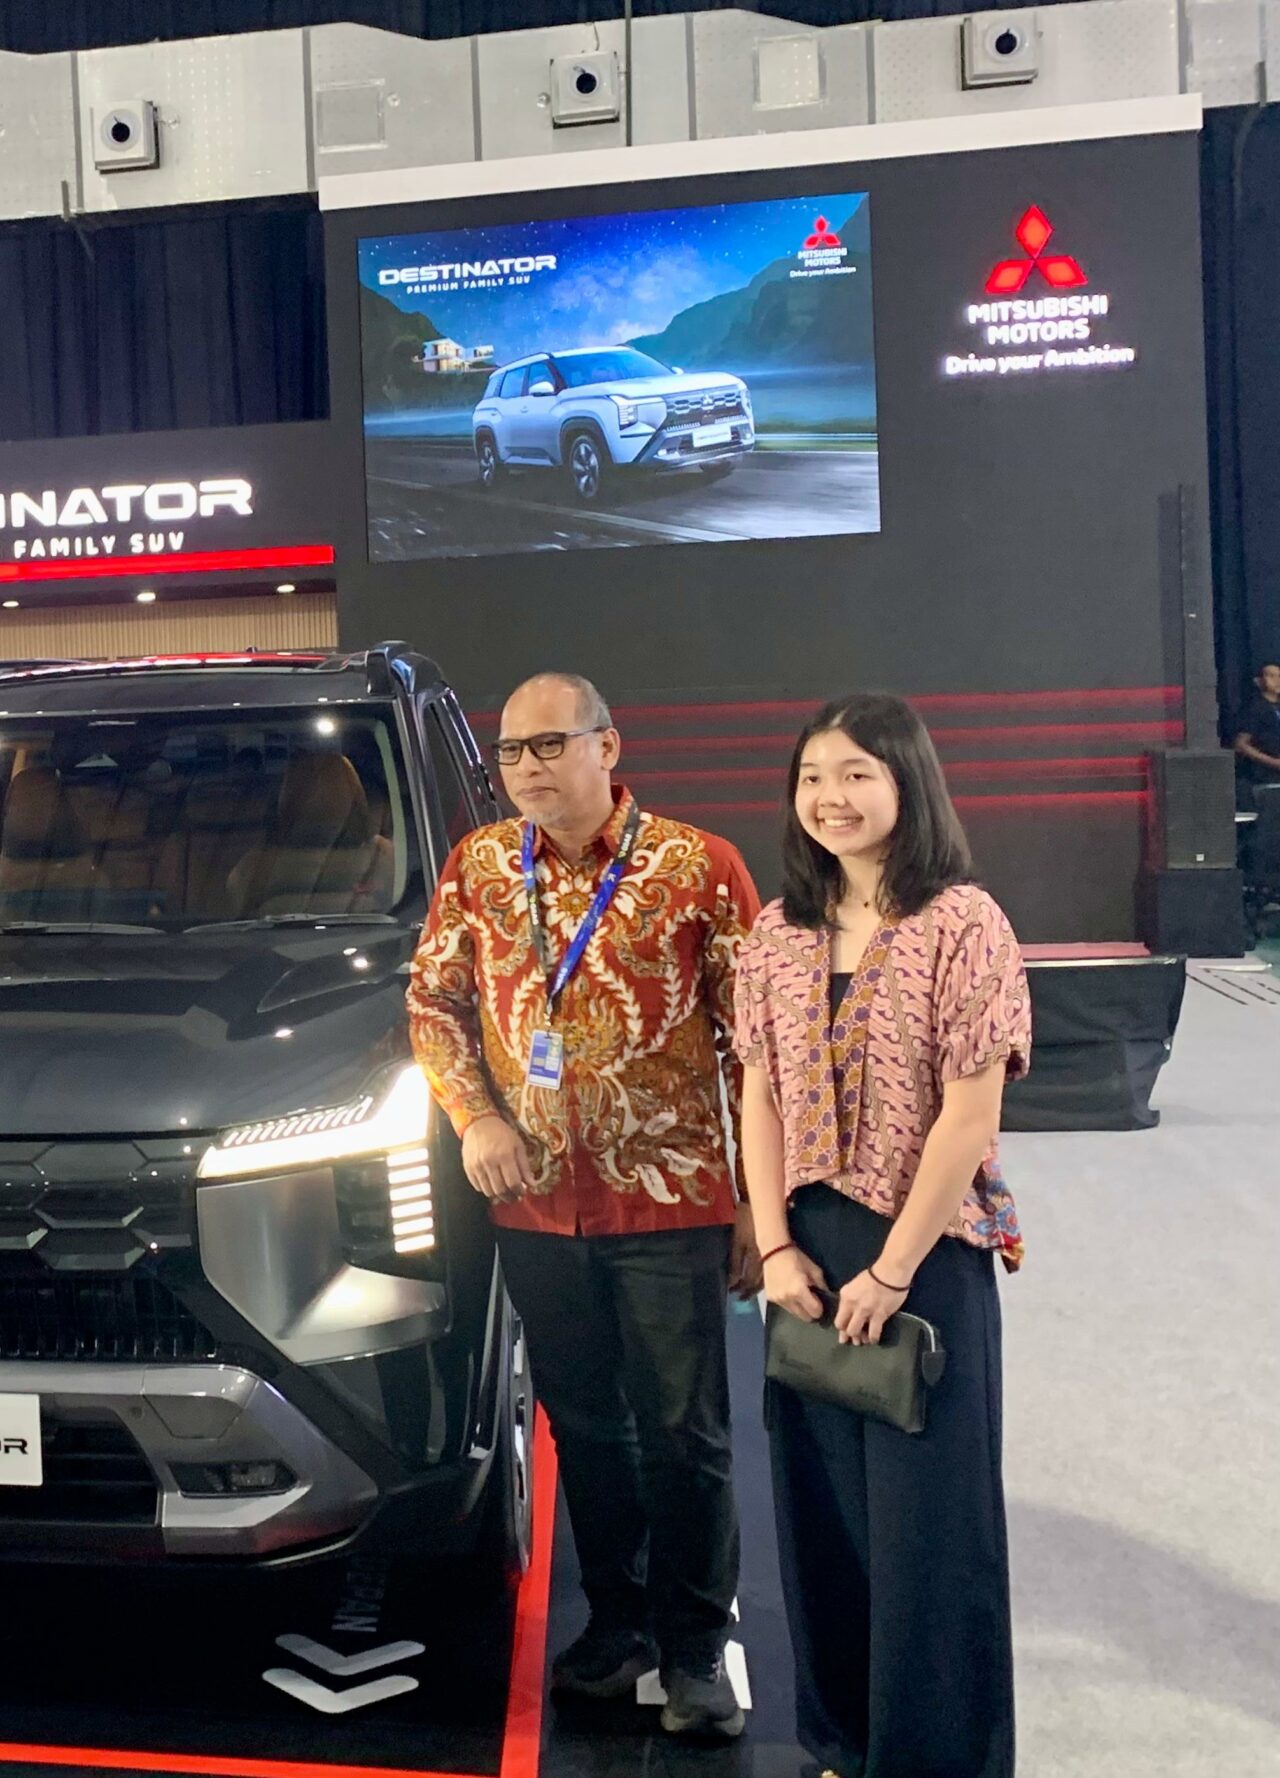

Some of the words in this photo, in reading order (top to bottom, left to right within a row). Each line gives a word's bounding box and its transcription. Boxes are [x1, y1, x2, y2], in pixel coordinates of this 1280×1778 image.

[797, 247, 848, 259] MITSUBISHI
[804, 256, 841, 267] MOTORS
[378, 254, 557, 286] DESTINATOR
[406, 281, 459, 294] PREMIUM
[463, 278, 504, 290] FAMILY
[508, 275, 531, 286] SUV
[967, 295, 1109, 324] MITSUBISHI
[987, 318, 1091, 345] MOTORS
[944, 353, 997, 375] Drive
[998, 353, 1044, 374] your
[1043, 343, 1136, 367] Ambition
[13, 535, 117, 558] FAMILY
[130, 531, 185, 554] SUV
